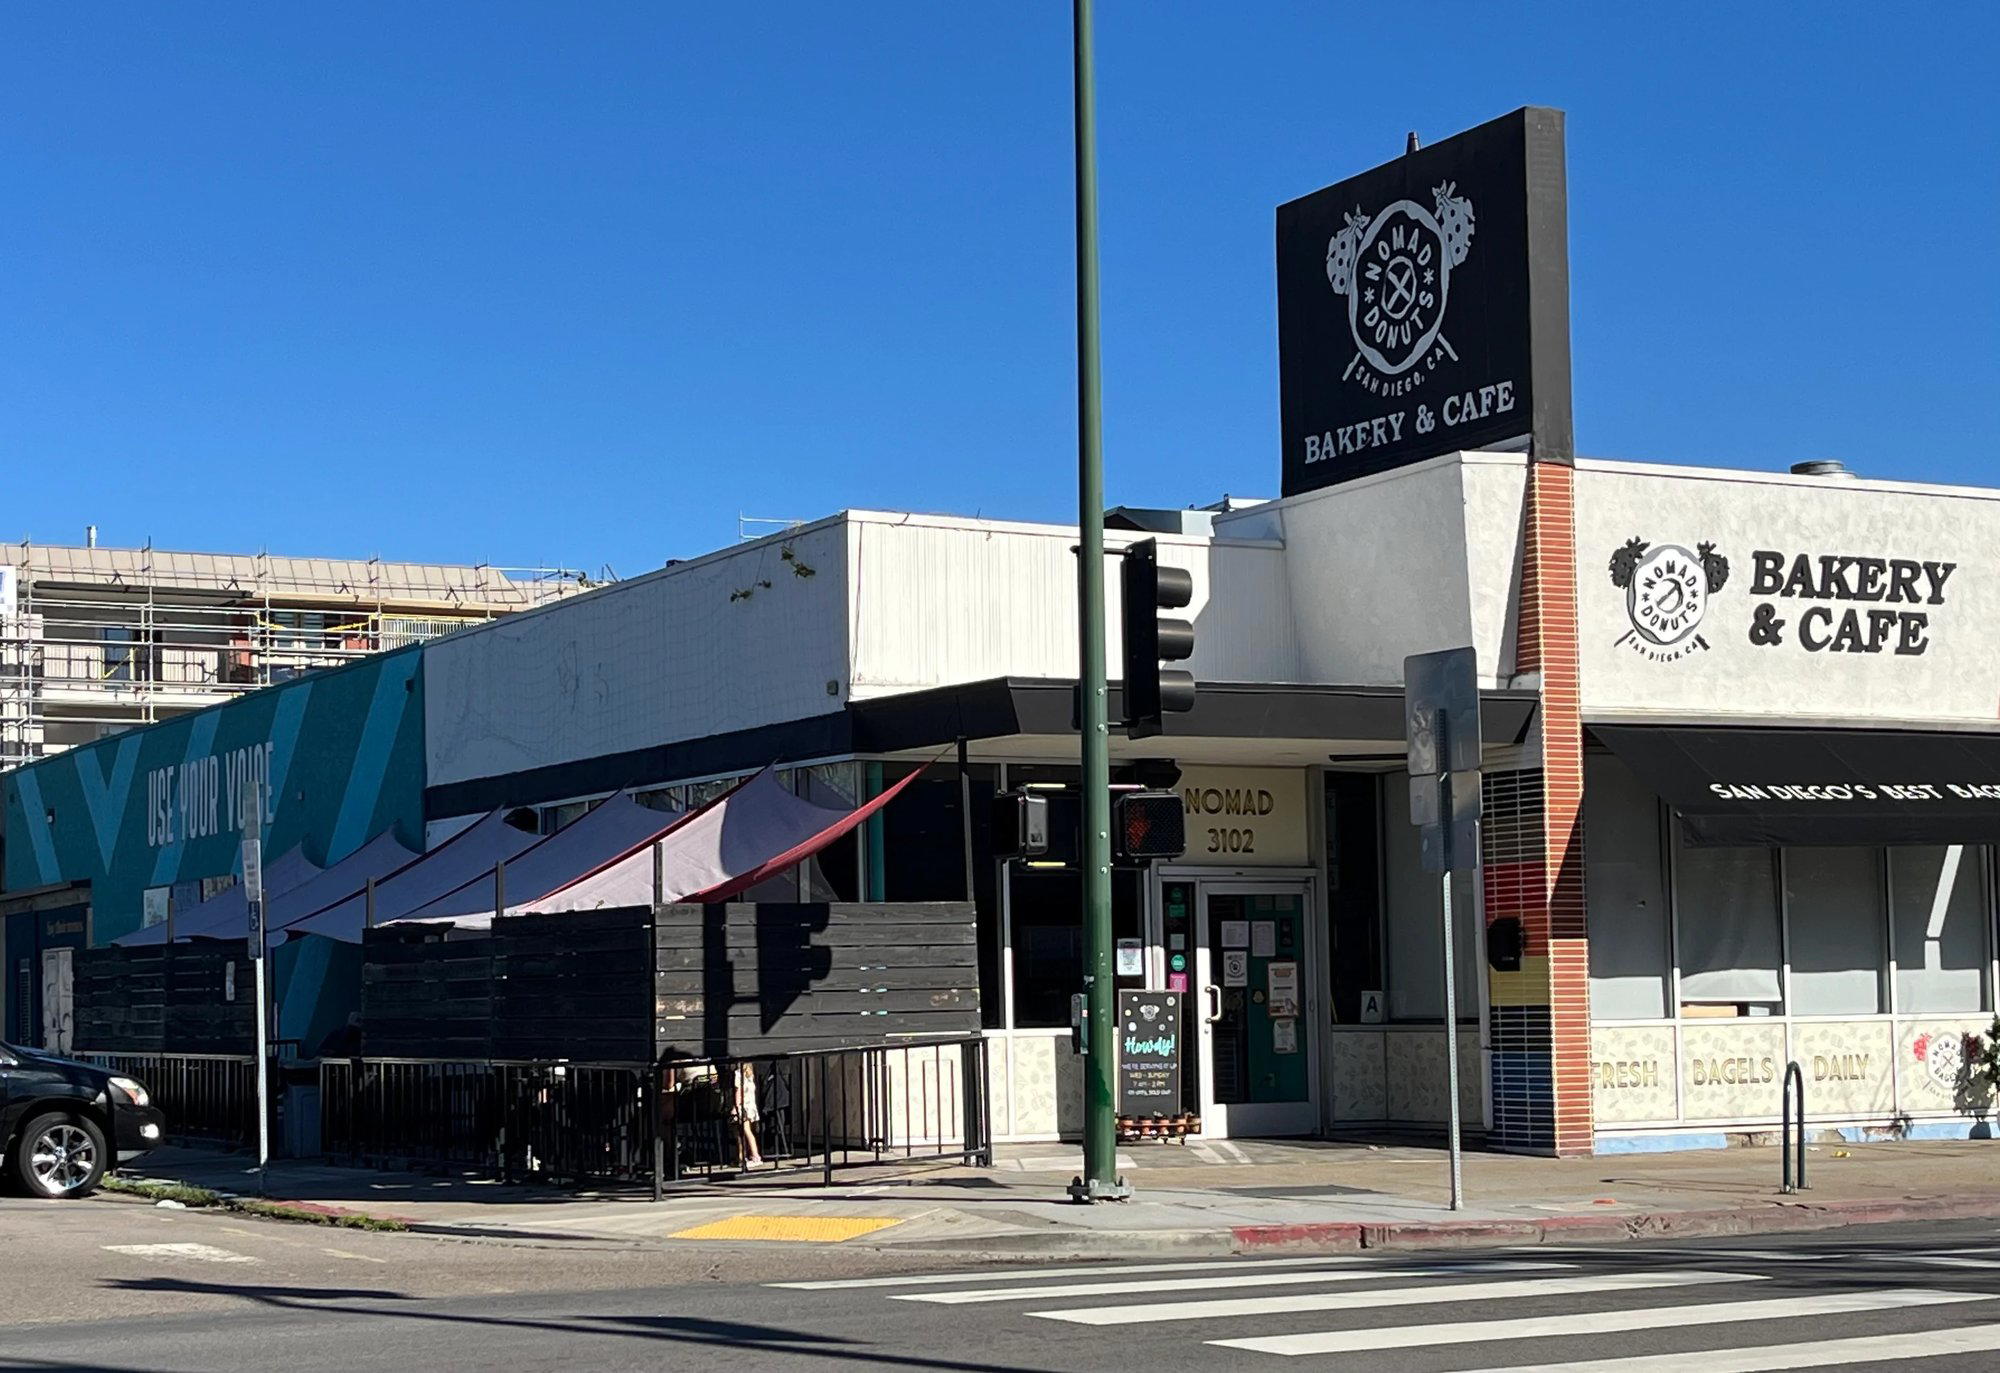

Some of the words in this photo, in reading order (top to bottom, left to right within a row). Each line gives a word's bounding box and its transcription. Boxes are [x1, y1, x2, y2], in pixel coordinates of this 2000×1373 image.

[1365, 224, 1432, 281] NOMAD
[1364, 291, 1434, 349] DONUTS
[1355, 366, 1378, 393] SAN
[1427, 348, 1444, 370] CA
[1415, 404, 1435, 434] &
[1443, 380, 1515, 427] CAFE
[1643, 560, 1697, 589] NOMAD
[1750, 550, 1957, 605] BAKERY
[1641, 601, 1698, 632] DONUTS
[1749, 603, 1785, 646] &
[1799, 606, 1929, 656] CAFE
[1629, 636, 1646, 654] SAN
[1685, 641, 1698, 654] CA
[148, 766, 174, 847] USE
[180, 755, 218, 840] YOUR
[1184, 788, 1274, 816] NOMAD
[1710, 783, 1771, 800] SAN
[1767, 783, 1878, 800] DIEGO'S
[1878, 784, 1943, 800] BEST
[1207, 828, 1254, 853] 3102
[1366, 996, 1378, 1012] A
[1124, 1034, 1175, 1057] Howdy!
[1590, 1061, 1658, 1088] FRESH
[1693, 1057, 1774, 1086] BAGELS
[1814, 1054, 1870, 1081] DAILY
